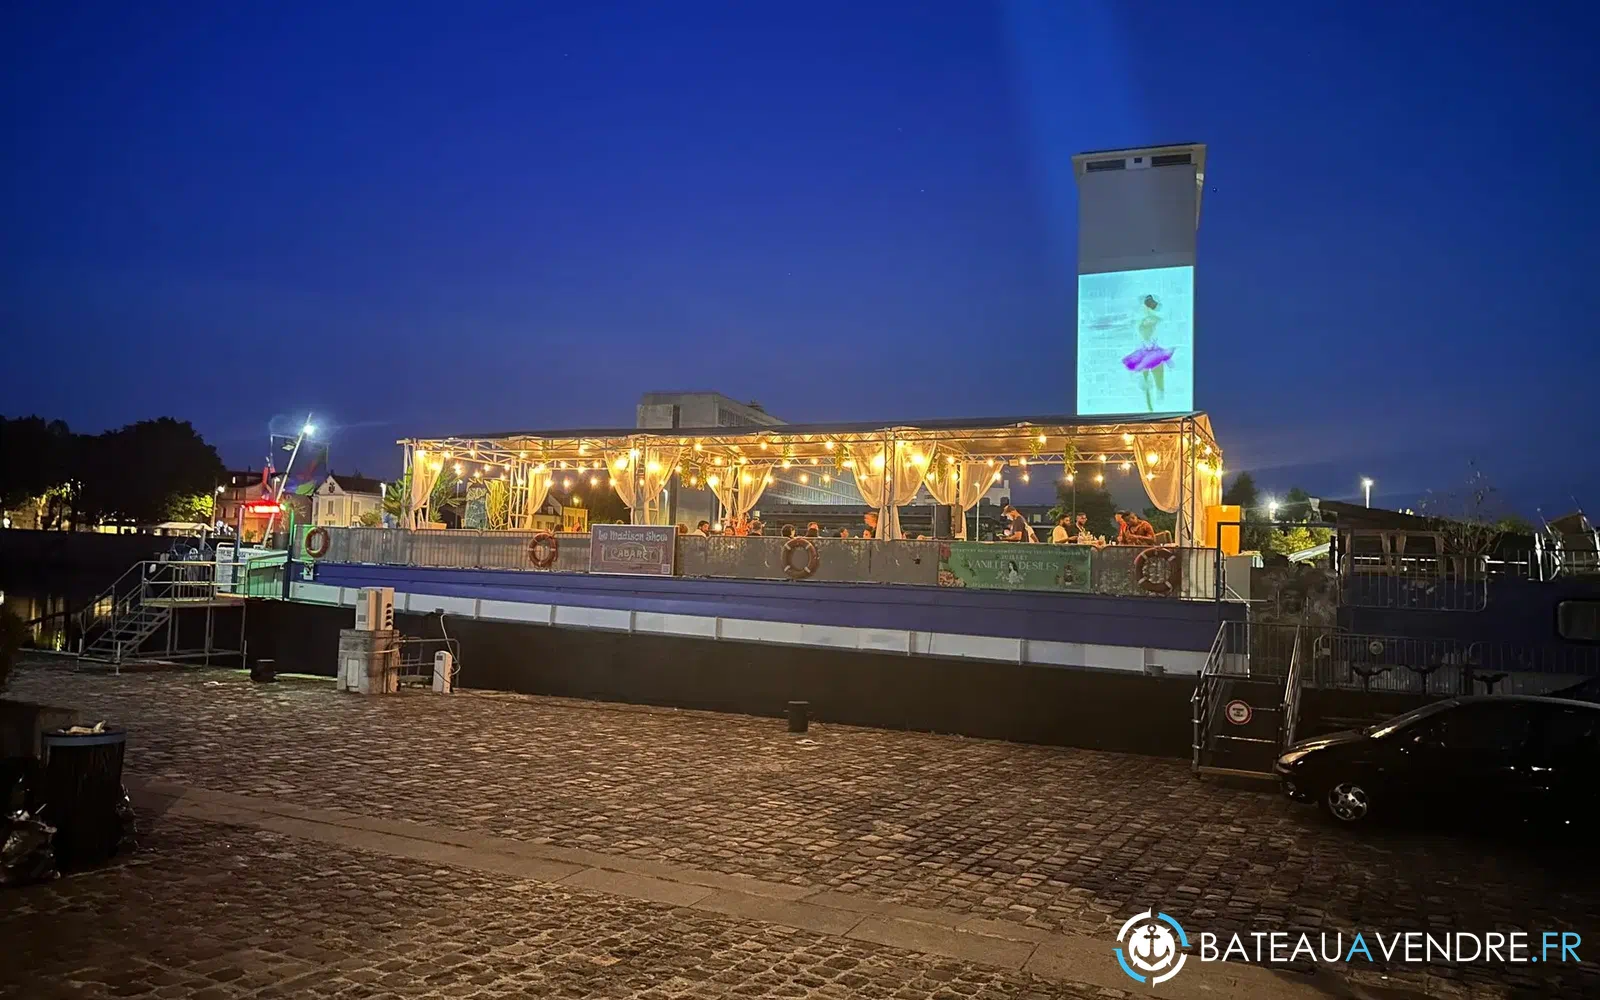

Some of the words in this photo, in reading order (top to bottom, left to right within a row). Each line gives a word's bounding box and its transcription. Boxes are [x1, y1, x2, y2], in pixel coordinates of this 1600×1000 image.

[598, 529, 608, 540] Le
[610, 530, 645, 542] Madison
[645, 531, 668, 542] Show
[611, 545, 654, 561] CABARET
